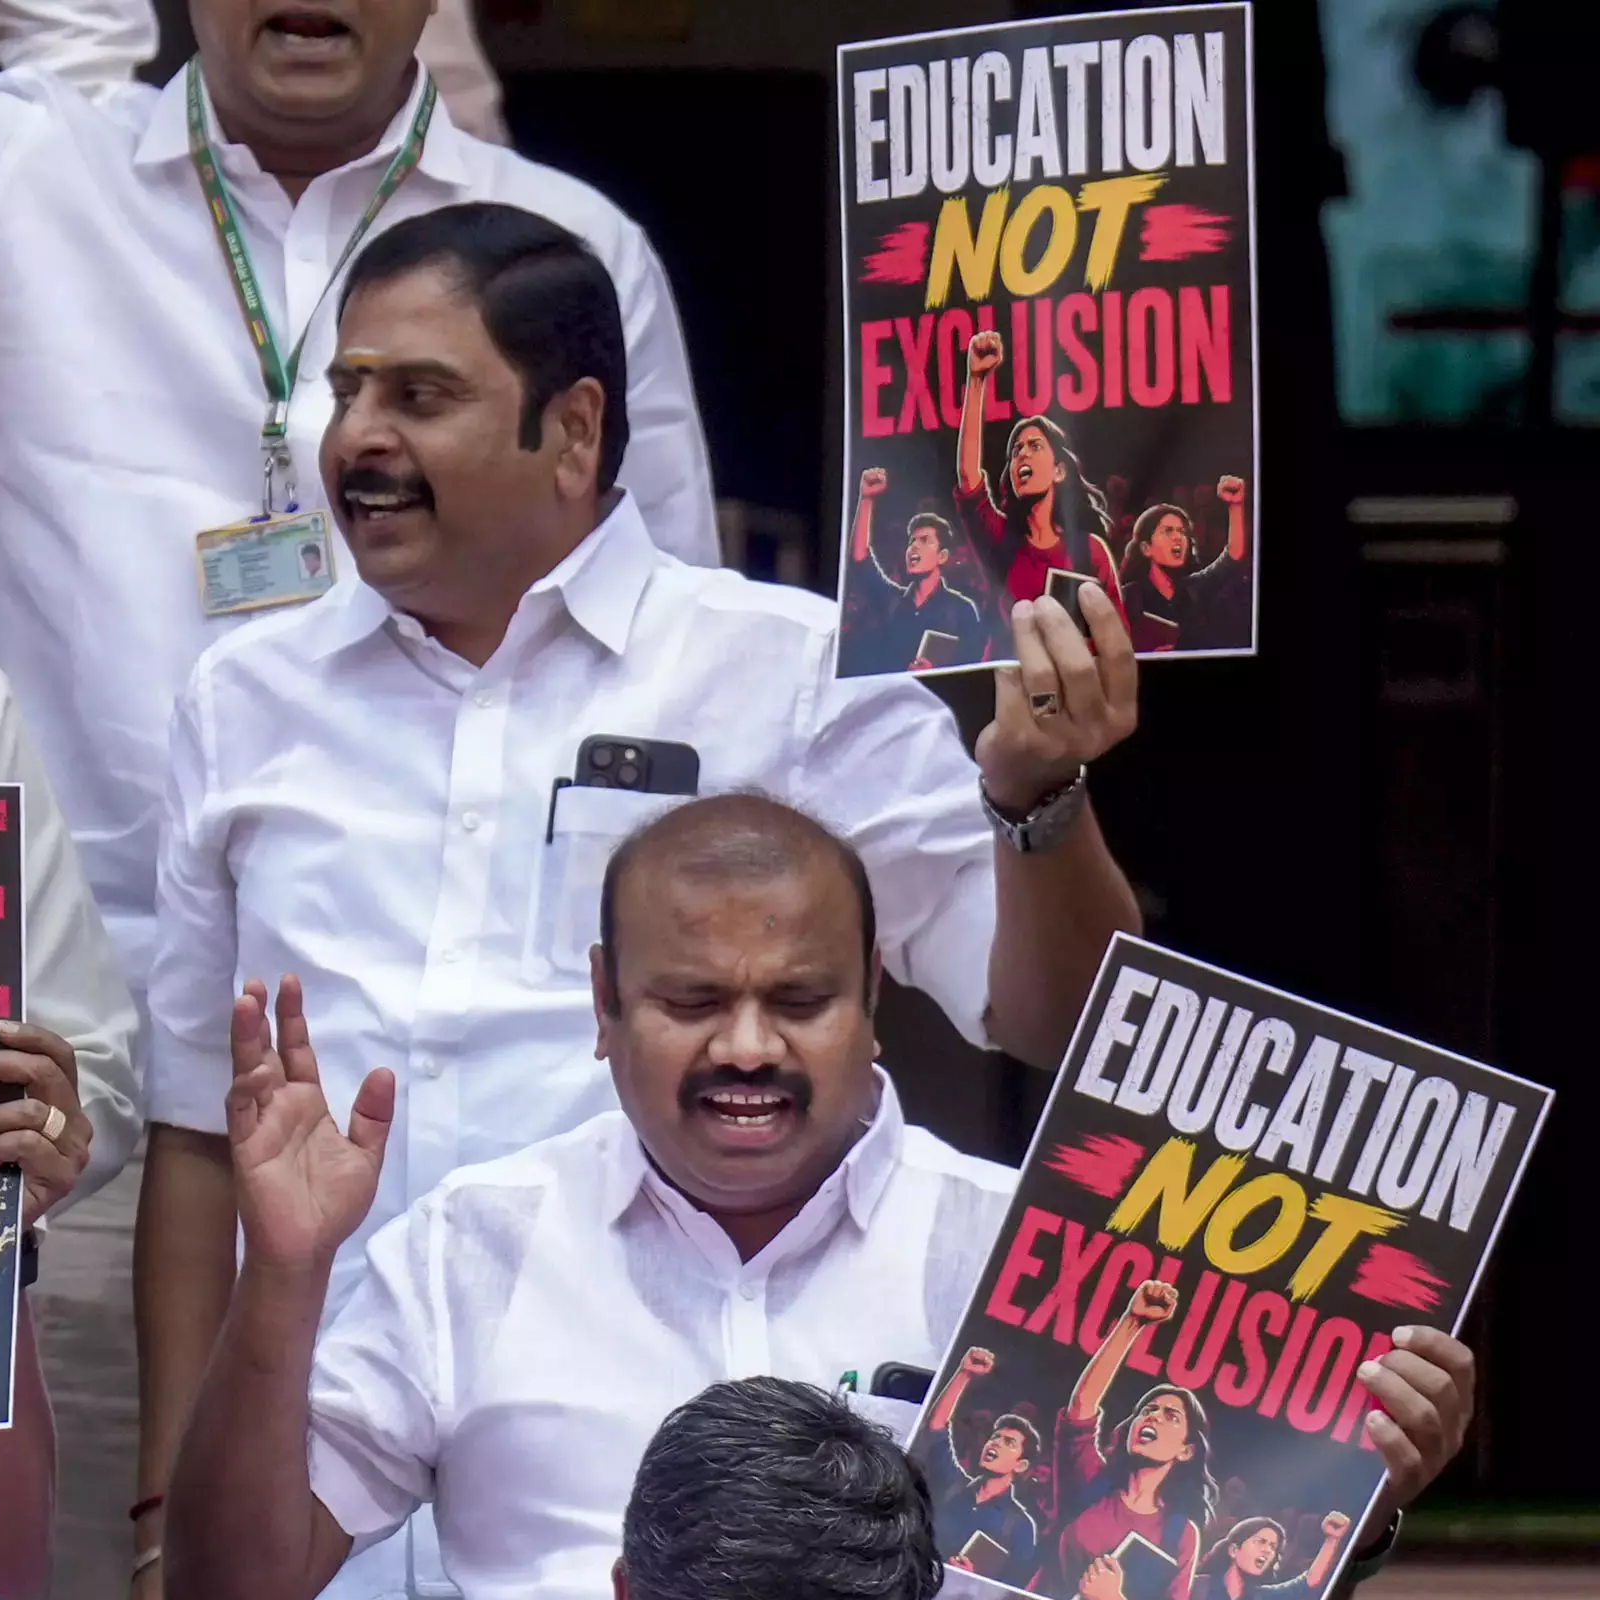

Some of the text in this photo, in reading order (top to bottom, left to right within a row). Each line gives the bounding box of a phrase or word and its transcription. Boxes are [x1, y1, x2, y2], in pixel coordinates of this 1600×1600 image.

[853, 31, 1228, 204] EDUCATION
[924, 172, 1170, 308] NOT
[860, 284, 1232, 439] EXCLUSION
[1073, 966, 1518, 1231] EDUCATION
[1105, 1136, 1408, 1302] NOT
